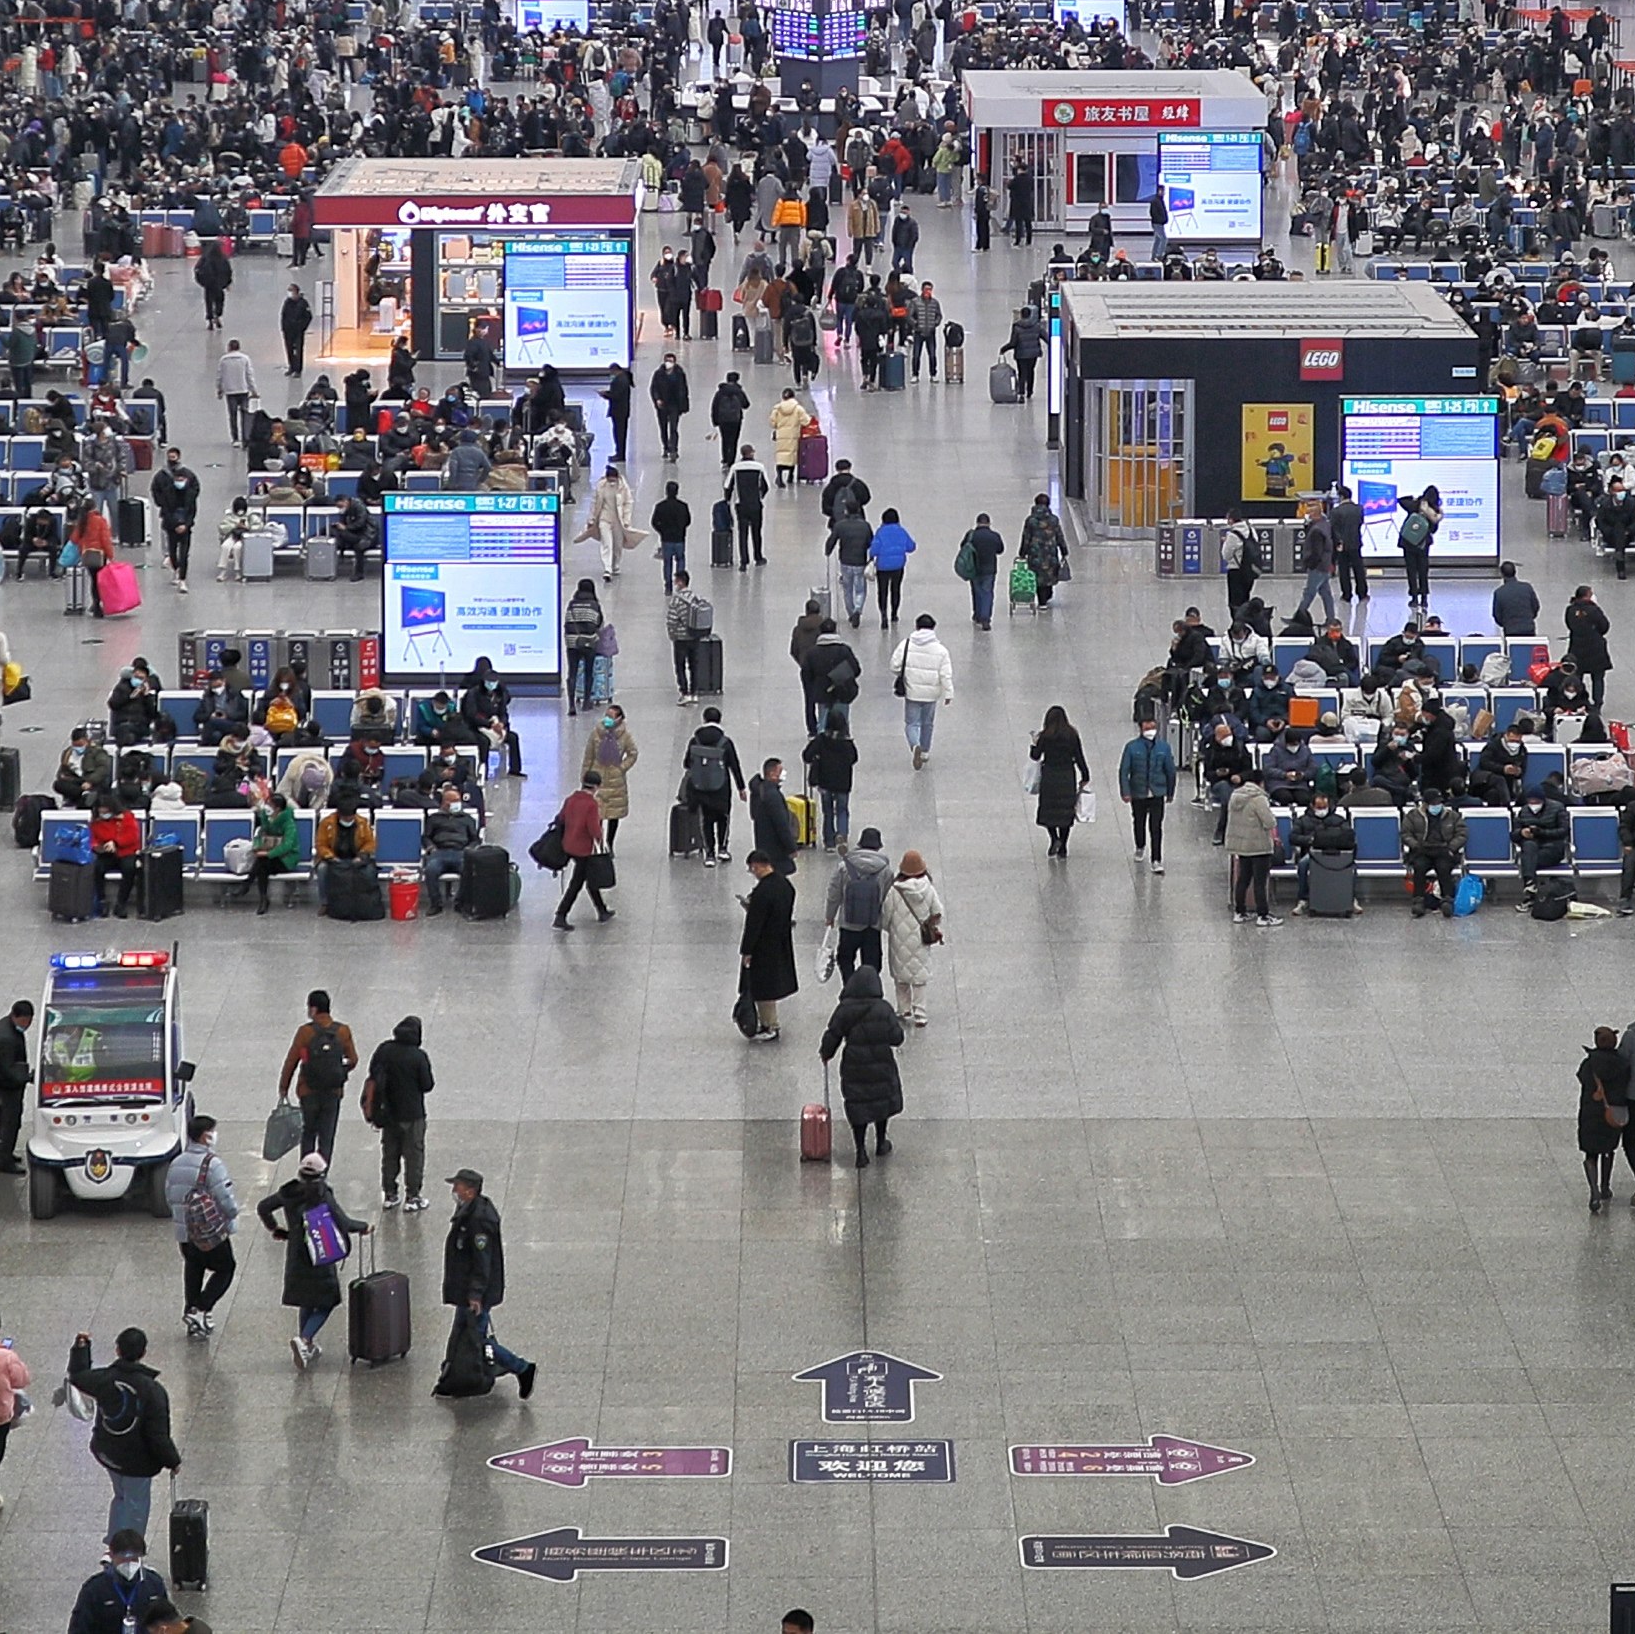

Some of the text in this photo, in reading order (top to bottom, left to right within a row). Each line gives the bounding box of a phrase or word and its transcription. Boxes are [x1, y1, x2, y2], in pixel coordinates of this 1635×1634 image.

[1084, 105, 1150, 122] 旅友书屋
[487, 202, 551, 223] 外交官
[511, 242, 563, 253] Hisense
[1302, 349, 1340, 369] LEGO
[1352, 400, 1416, 413] Hisense
[1269, 416, 1288, 426] LEGO
[394, 496, 517, 510] Hisense 1-27
[456, 606, 542, 617] 高效沟通 便捷协作
[805, 1444, 937, 1453] 上海虹桥站
[818, 1460, 925, 1472] 欢迎您
